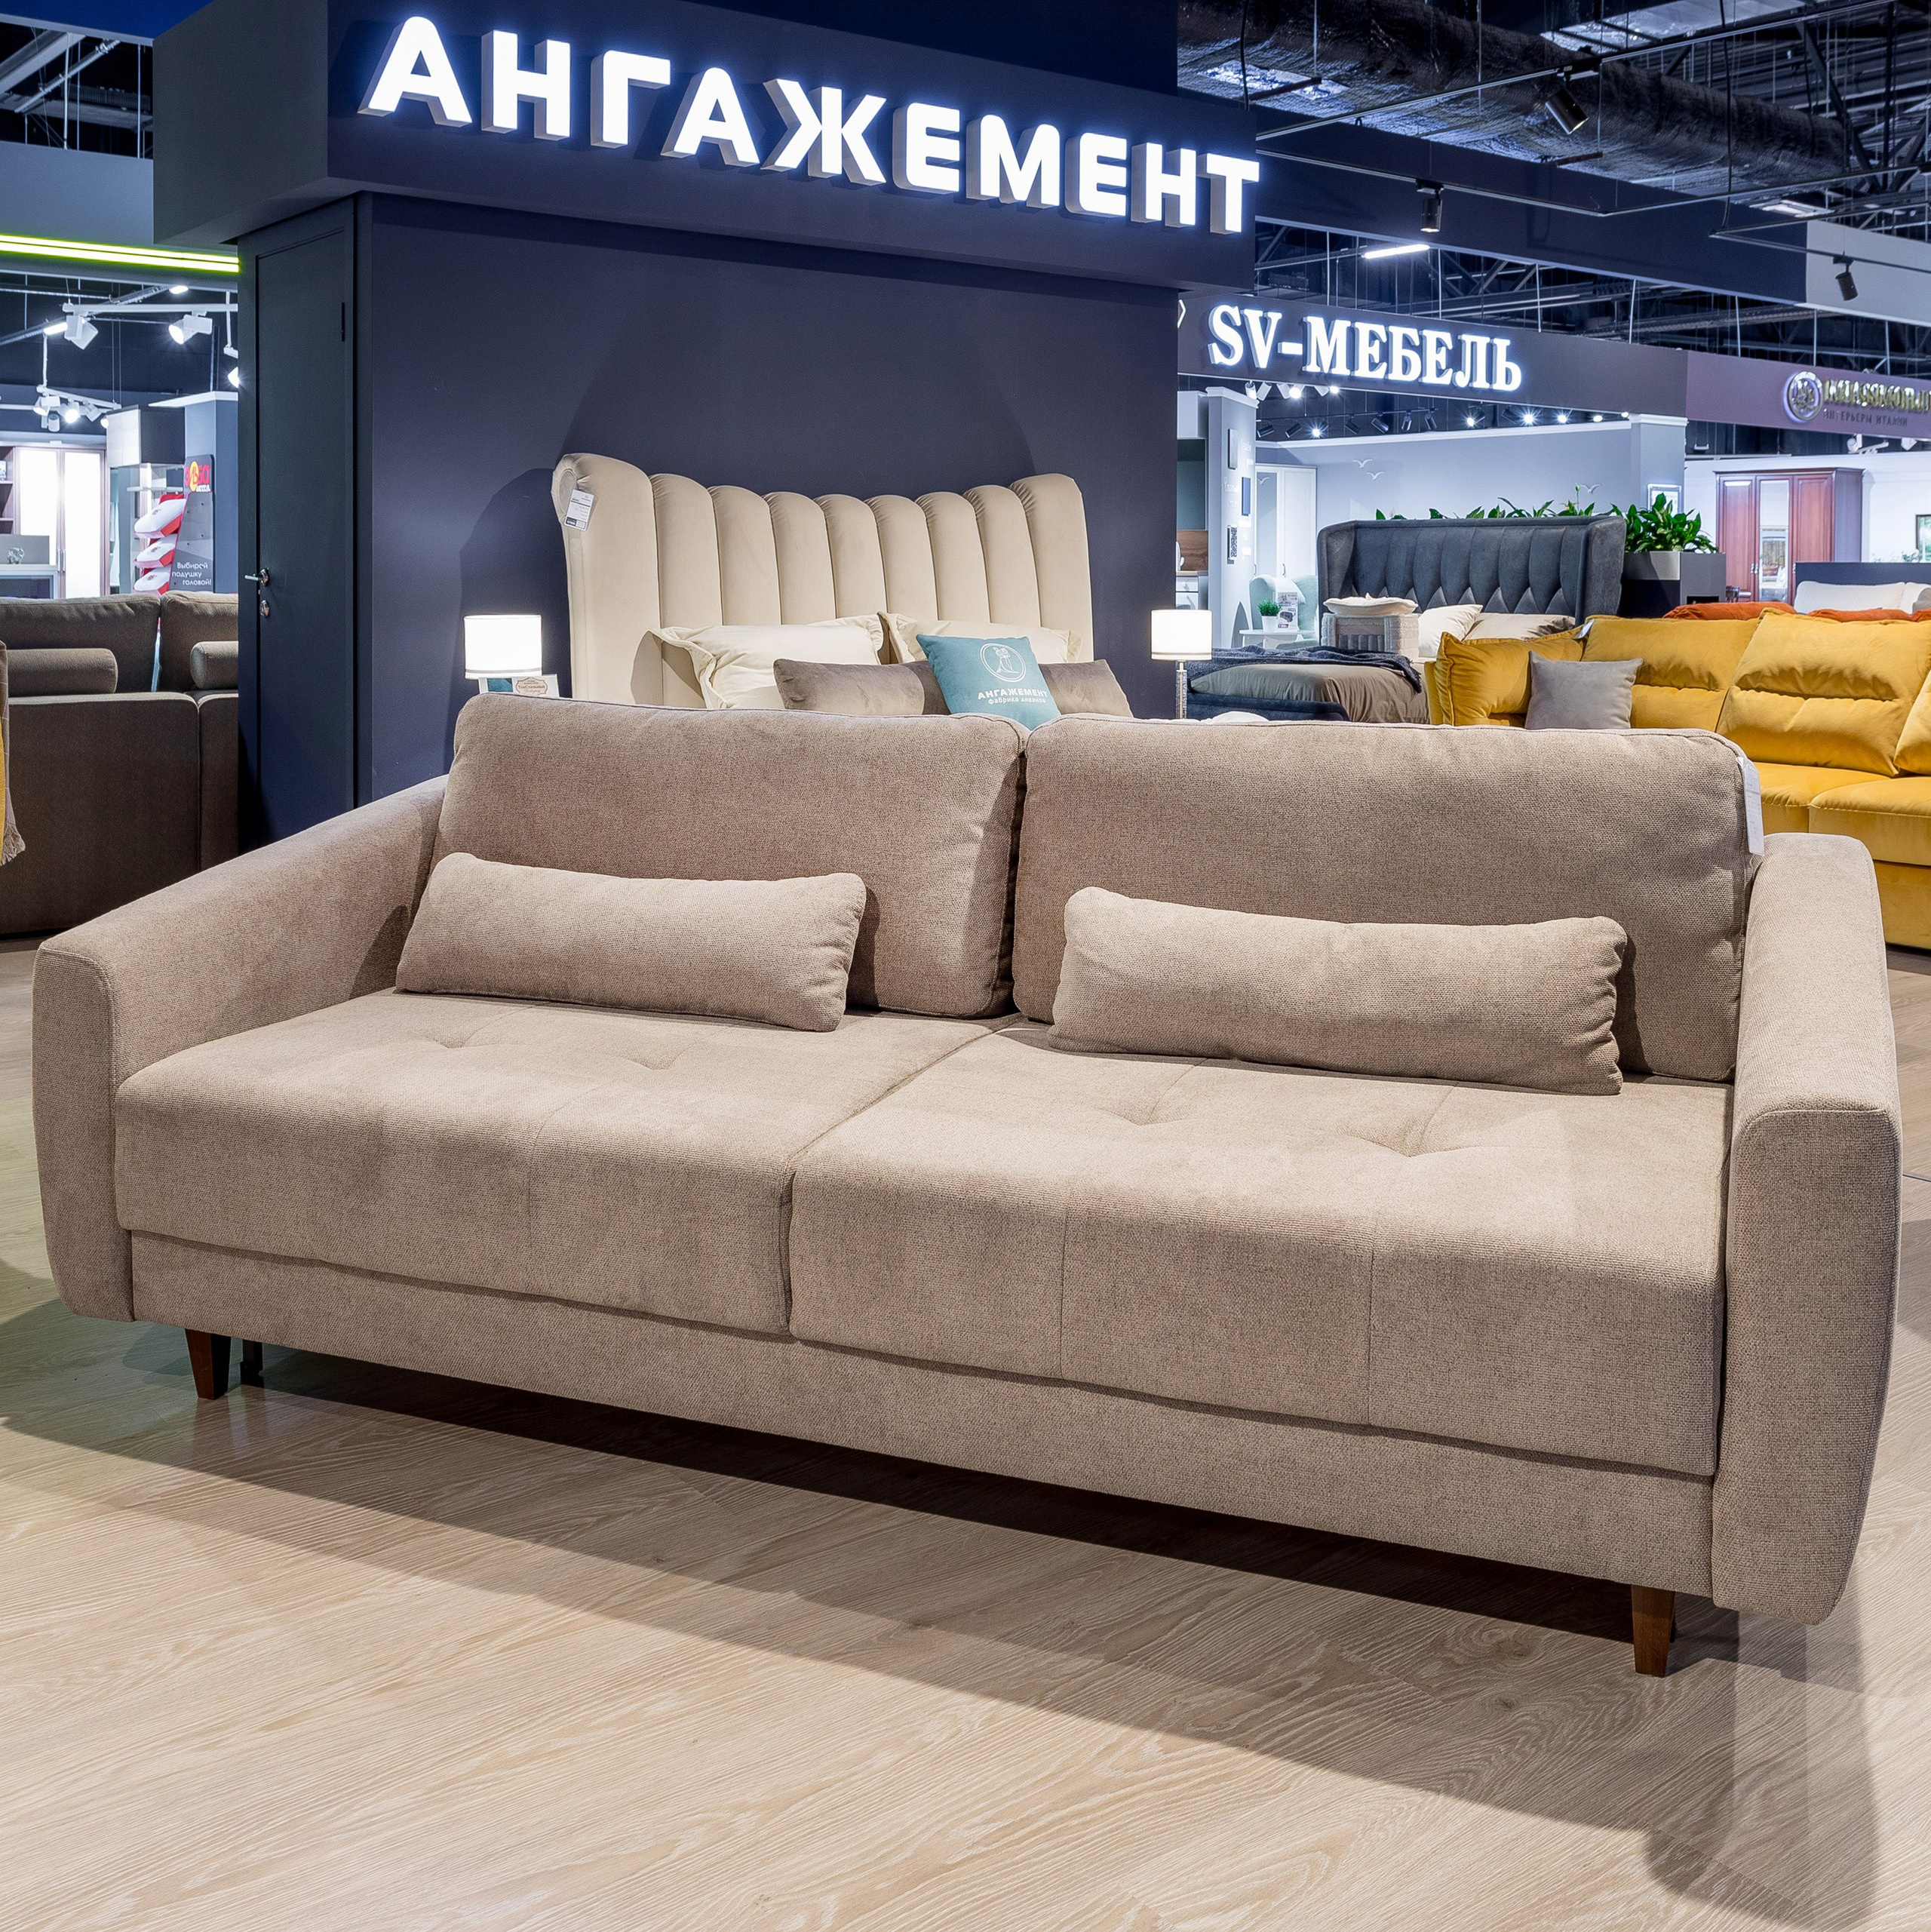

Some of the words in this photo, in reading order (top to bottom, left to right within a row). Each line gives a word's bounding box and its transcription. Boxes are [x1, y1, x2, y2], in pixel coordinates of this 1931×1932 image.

[362, 15, 1260, 234] АНГАЖЕМЕНТ
[1208, 305, 1522, 392] SV-МЕБЕЛЬ
[978, 688, 1048, 700] АНГАЖЕМЕНТ
[988, 696, 1019, 705] фабрика
